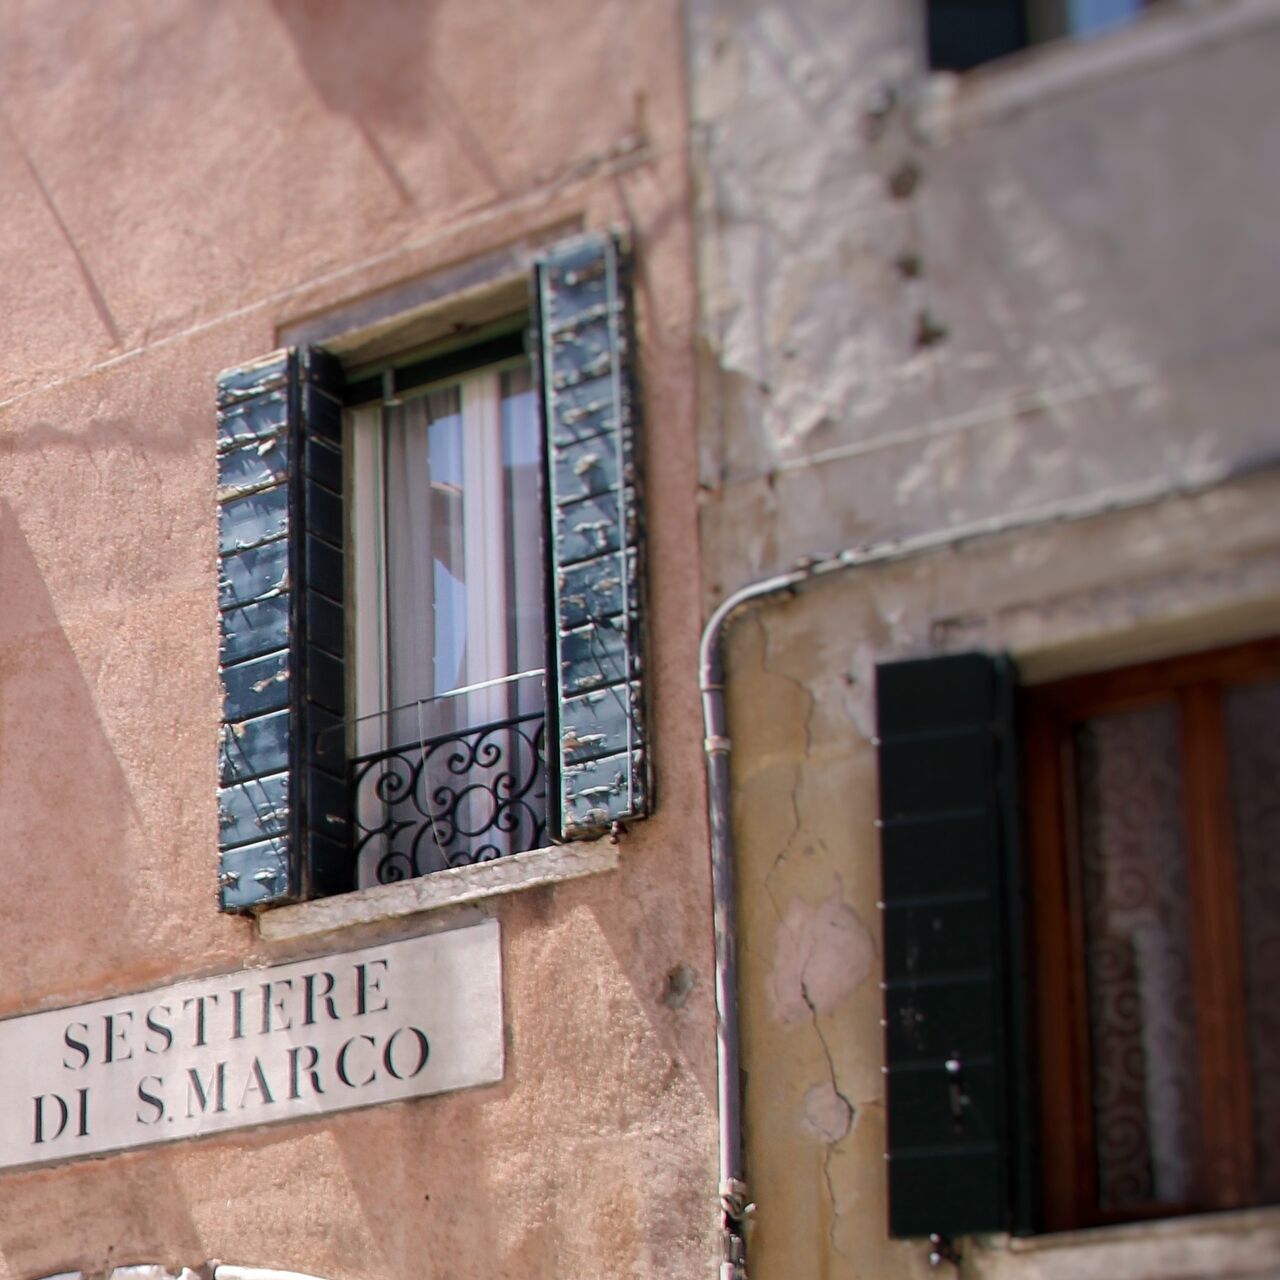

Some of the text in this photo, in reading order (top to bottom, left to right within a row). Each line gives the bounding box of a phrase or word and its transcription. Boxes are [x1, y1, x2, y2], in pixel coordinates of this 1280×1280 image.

[63, 959, 389, 1070] SESTIERE
[31, 1026, 431, 1145] DI S.MARCO
